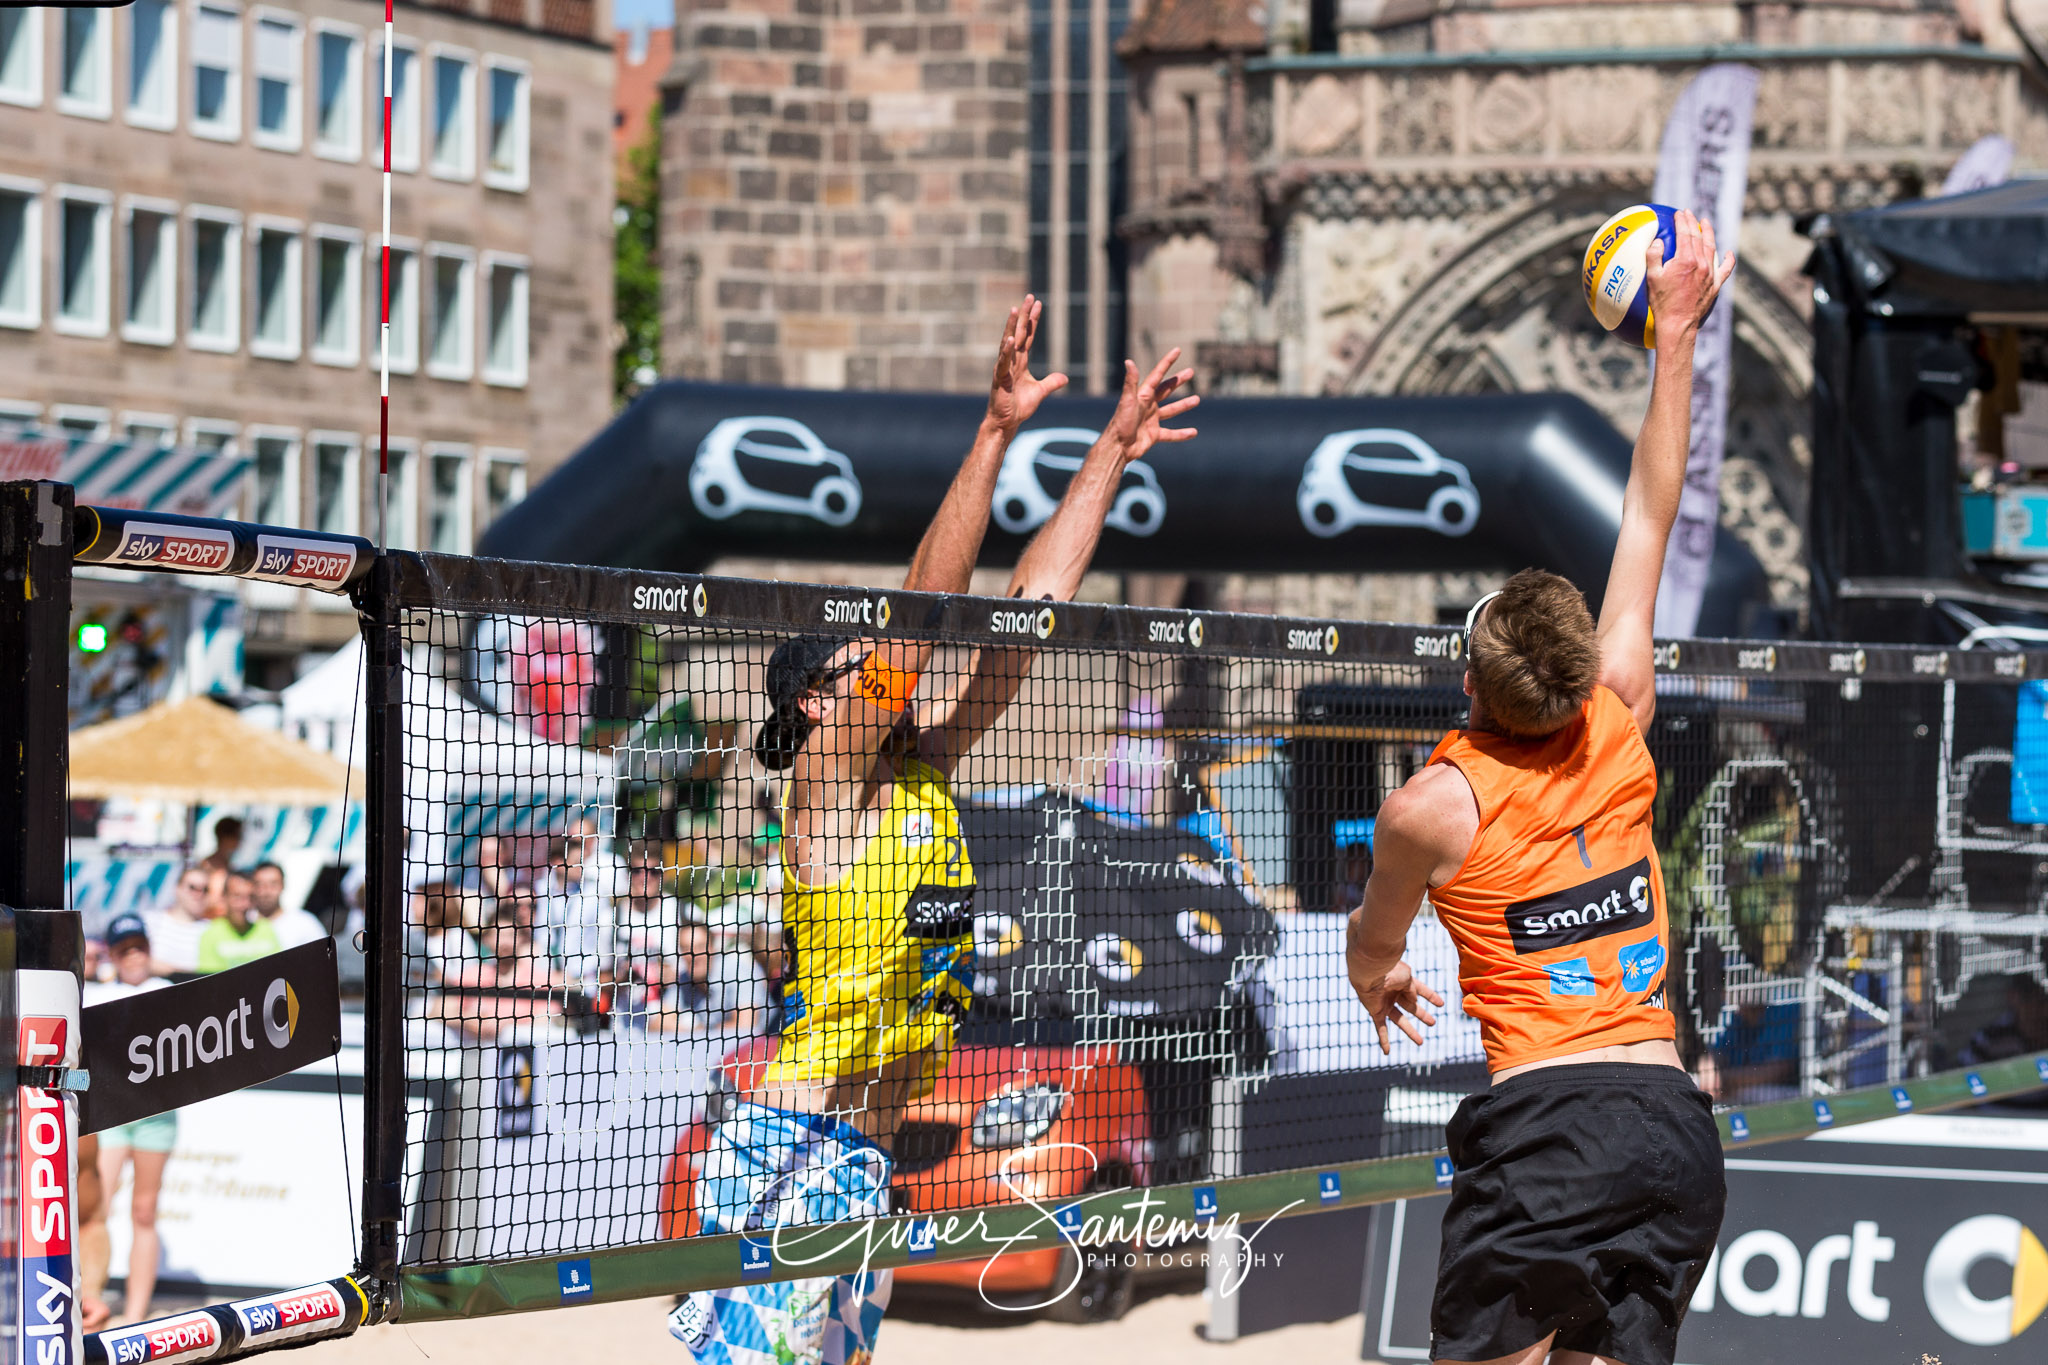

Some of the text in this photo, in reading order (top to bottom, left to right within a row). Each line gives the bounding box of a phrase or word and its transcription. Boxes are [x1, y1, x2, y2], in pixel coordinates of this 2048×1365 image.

[125, 535, 229, 565] sky SPORT
[263, 548, 349, 578] sky SPORT
[632, 584, 687, 613] smart
[824, 597, 872, 625] smart
[1149, 619, 1185, 643] smart
[1287, 627, 1323, 651] smart
[1523, 889, 1628, 935] smart
[128, 997, 254, 1084] smart
[1689, 1220, 1896, 1323] art
[251, 1293, 335, 1331] sky SPORT
[118, 1321, 210, 1364] sky SPORT
